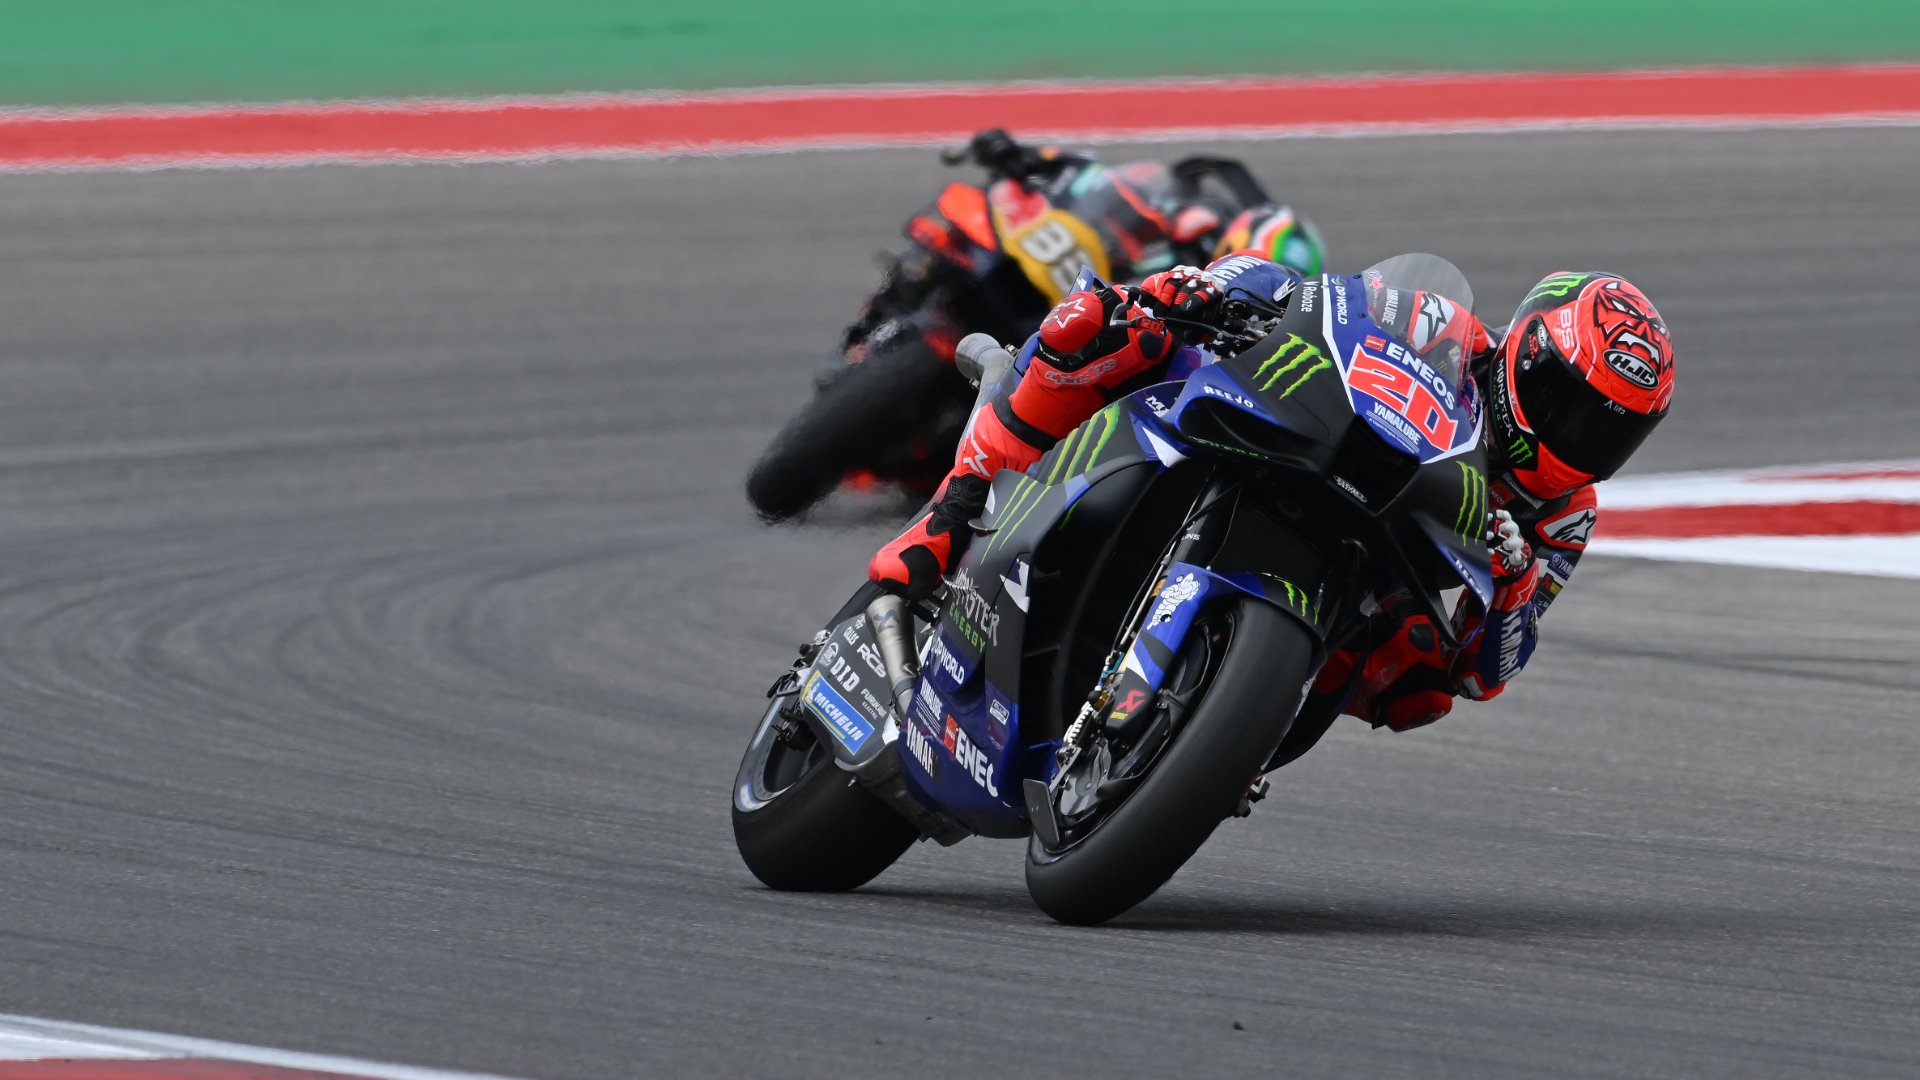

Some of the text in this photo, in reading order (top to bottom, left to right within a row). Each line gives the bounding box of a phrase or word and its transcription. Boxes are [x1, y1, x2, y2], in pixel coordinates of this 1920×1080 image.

[1301, 286, 1317, 312] Roboze
[1386, 342, 1455, 411] ENEOS
[1611, 355, 1655, 384] HJC
[1204, 386, 1254, 409] REEJO
[1347, 343, 1458, 452] 20
[1373, 402, 1422, 446] YAMALUBE
[949, 603, 987, 654] ENERGY
[814, 692, 865, 742] MICHELIN
[907, 717, 935, 777] YAMAH
